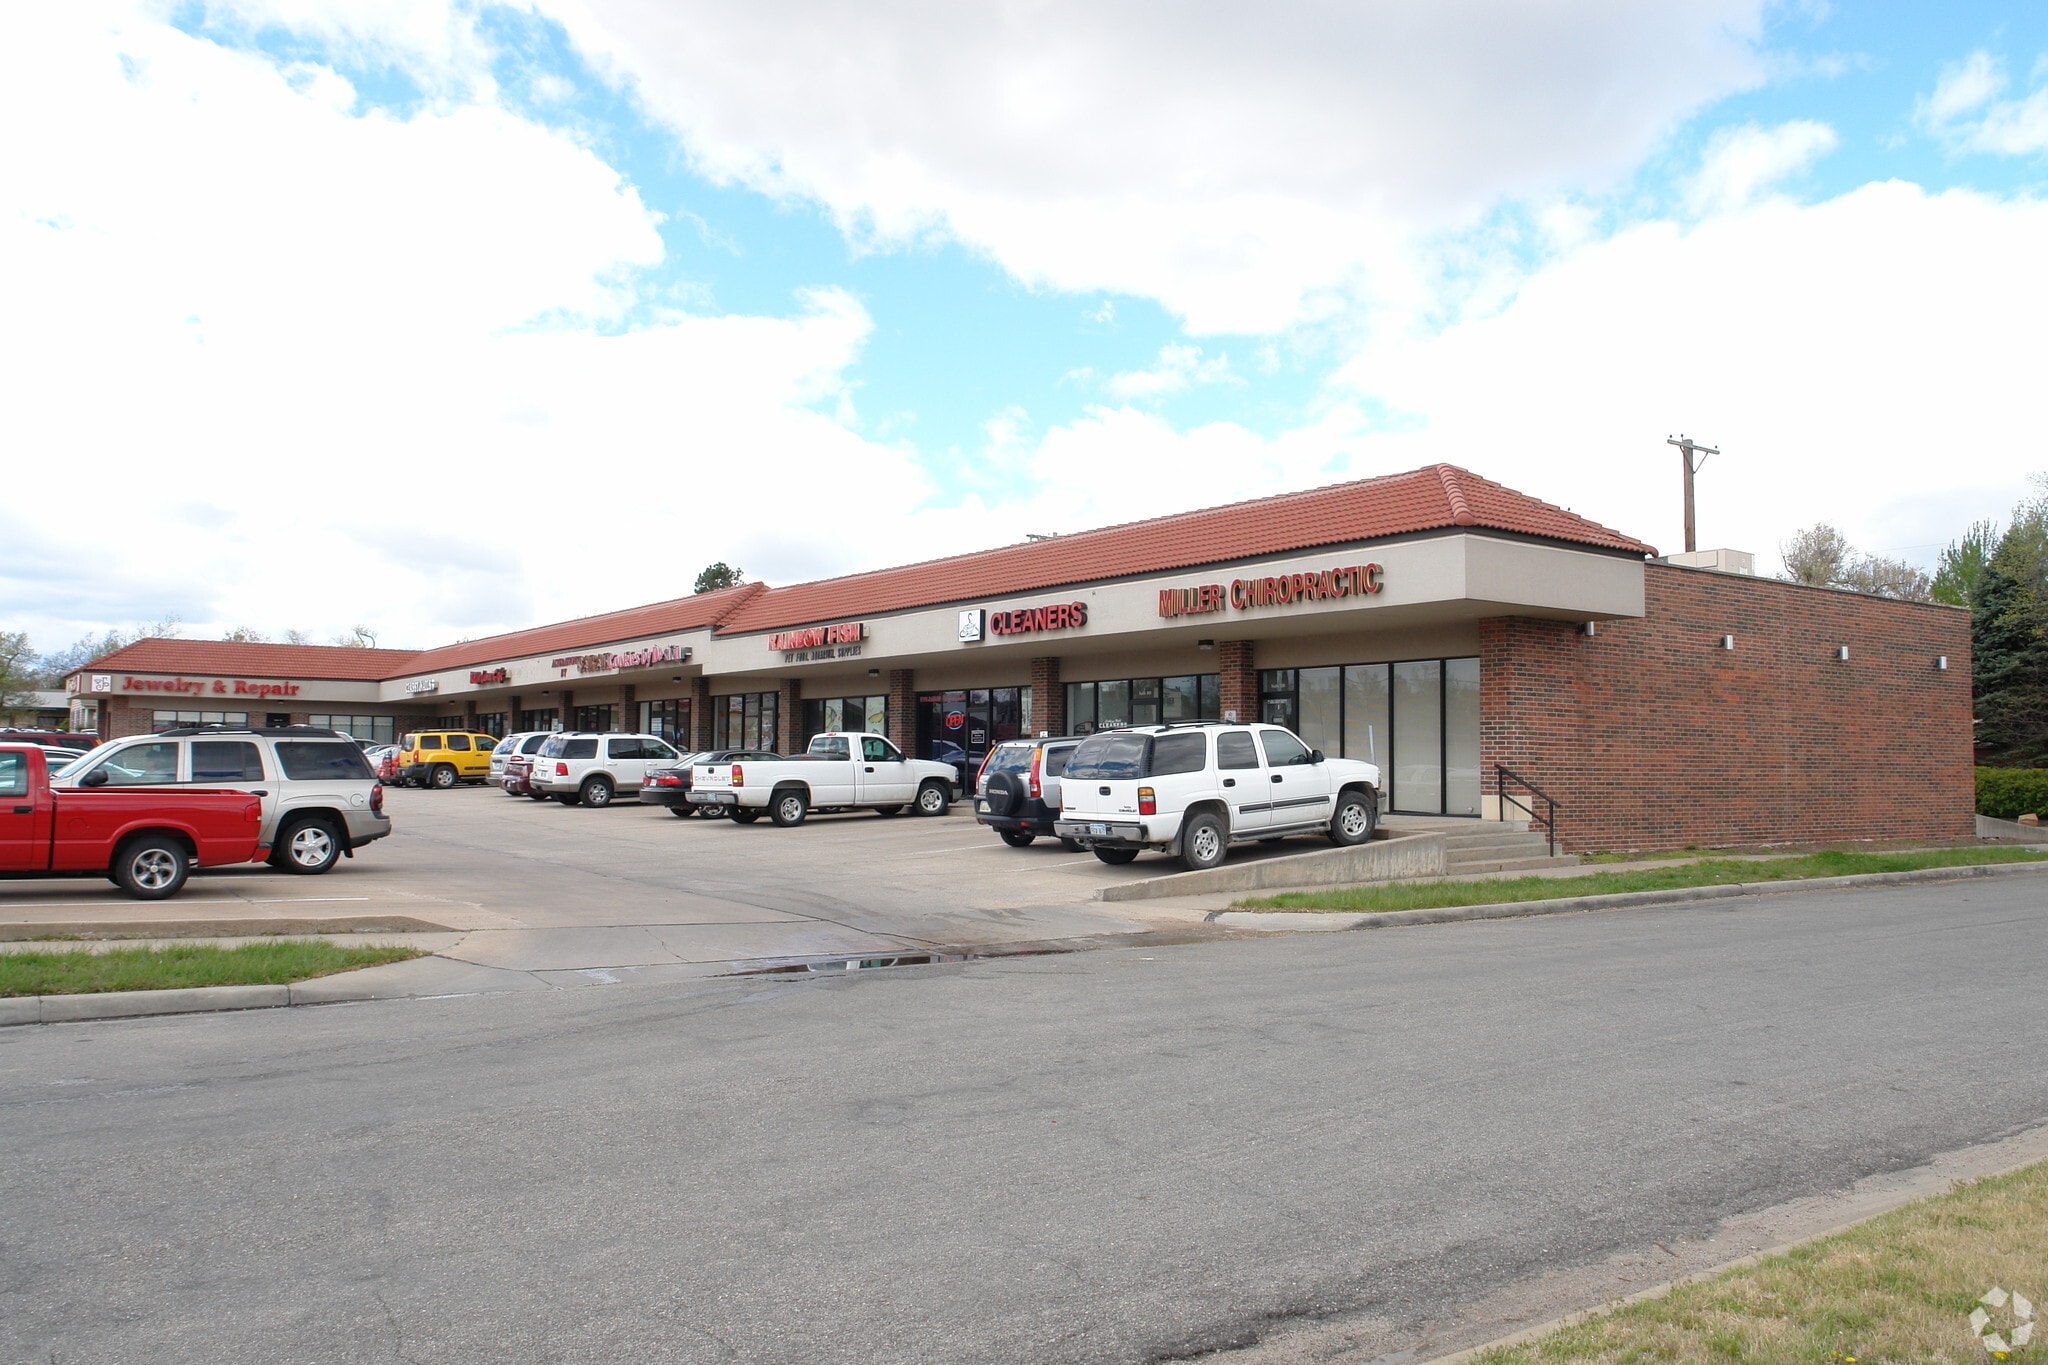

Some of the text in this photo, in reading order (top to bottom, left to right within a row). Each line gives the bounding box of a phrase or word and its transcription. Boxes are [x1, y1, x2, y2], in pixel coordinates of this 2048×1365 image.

[1159, 563, 1383, 617] MILLER CHIROPRACTIC
[990, 601, 1087, 635] CLEANERS
[768, 623, 863, 651] RAINBOW FISH
[122, 676, 300, 698] Jewelry & Repair
[945, 713, 965, 727] OPEN
